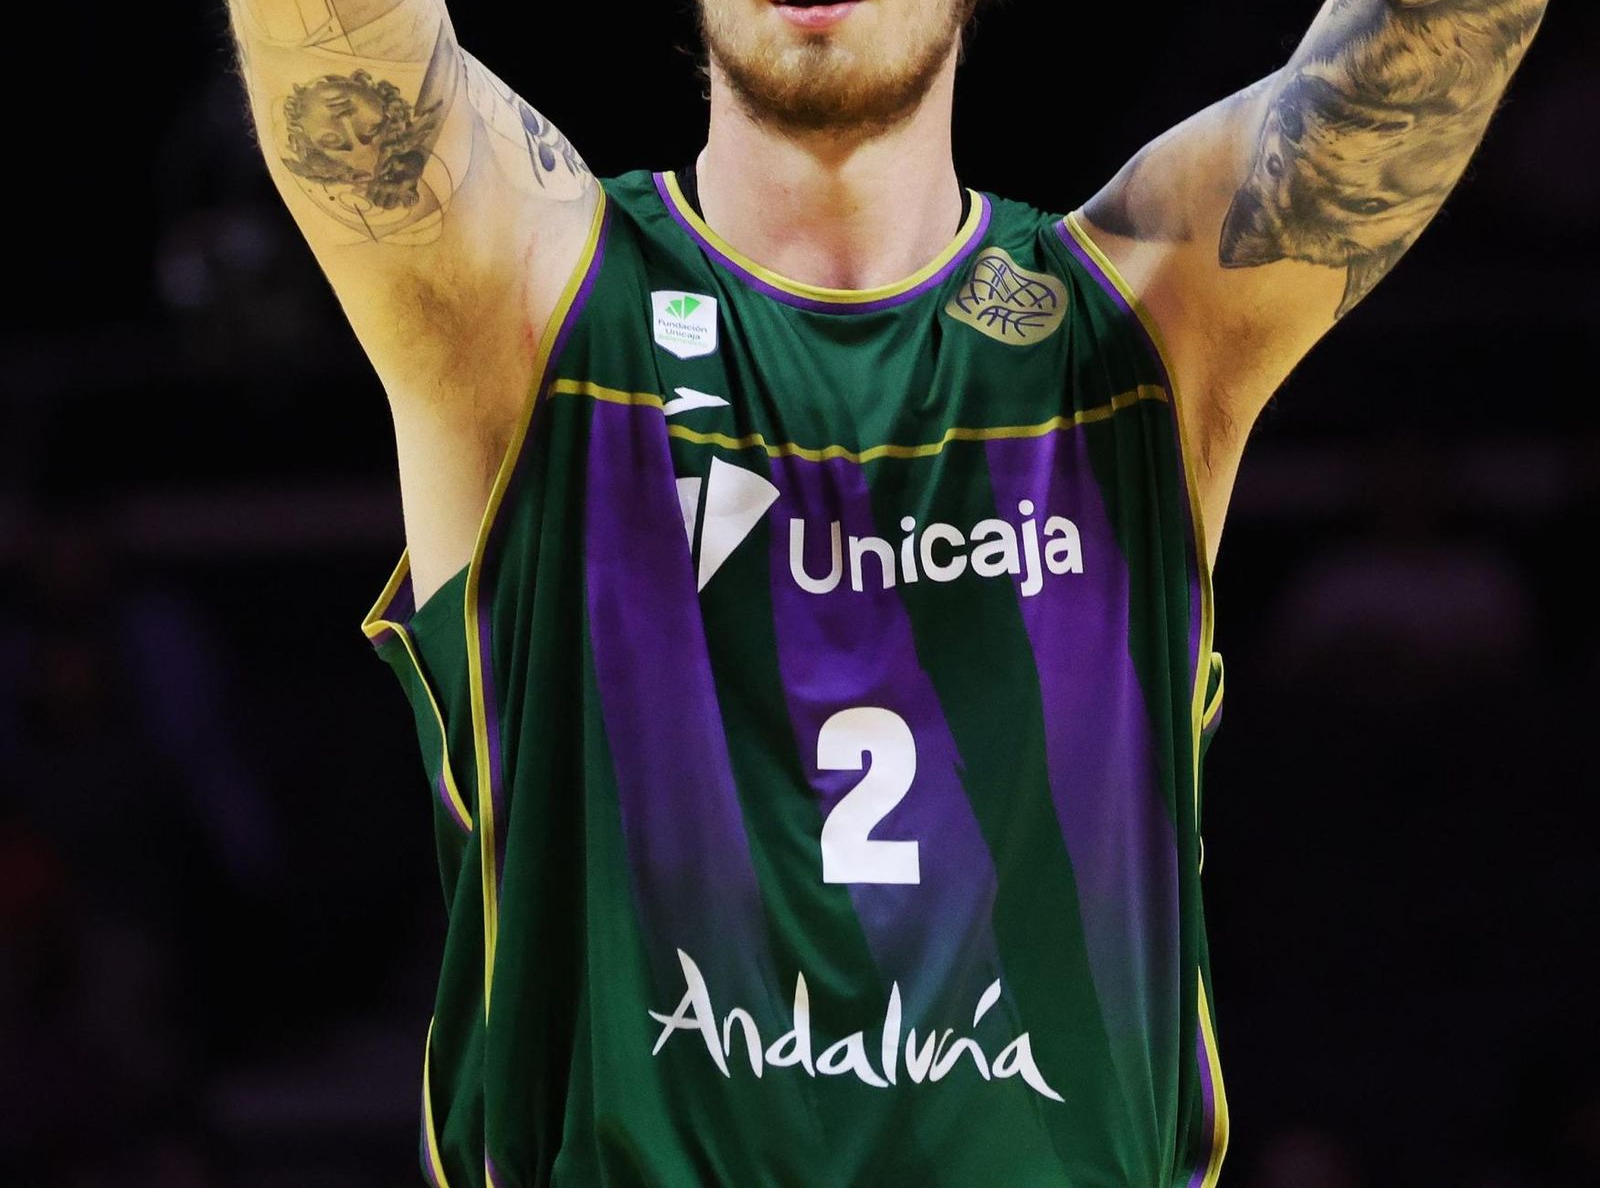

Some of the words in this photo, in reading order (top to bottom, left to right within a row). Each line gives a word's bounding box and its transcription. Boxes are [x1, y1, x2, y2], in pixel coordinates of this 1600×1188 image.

[789, 499, 1084, 597] Unicaja
[816, 706, 922, 885] 2
[649, 948, 1064, 1102] Andalucía
